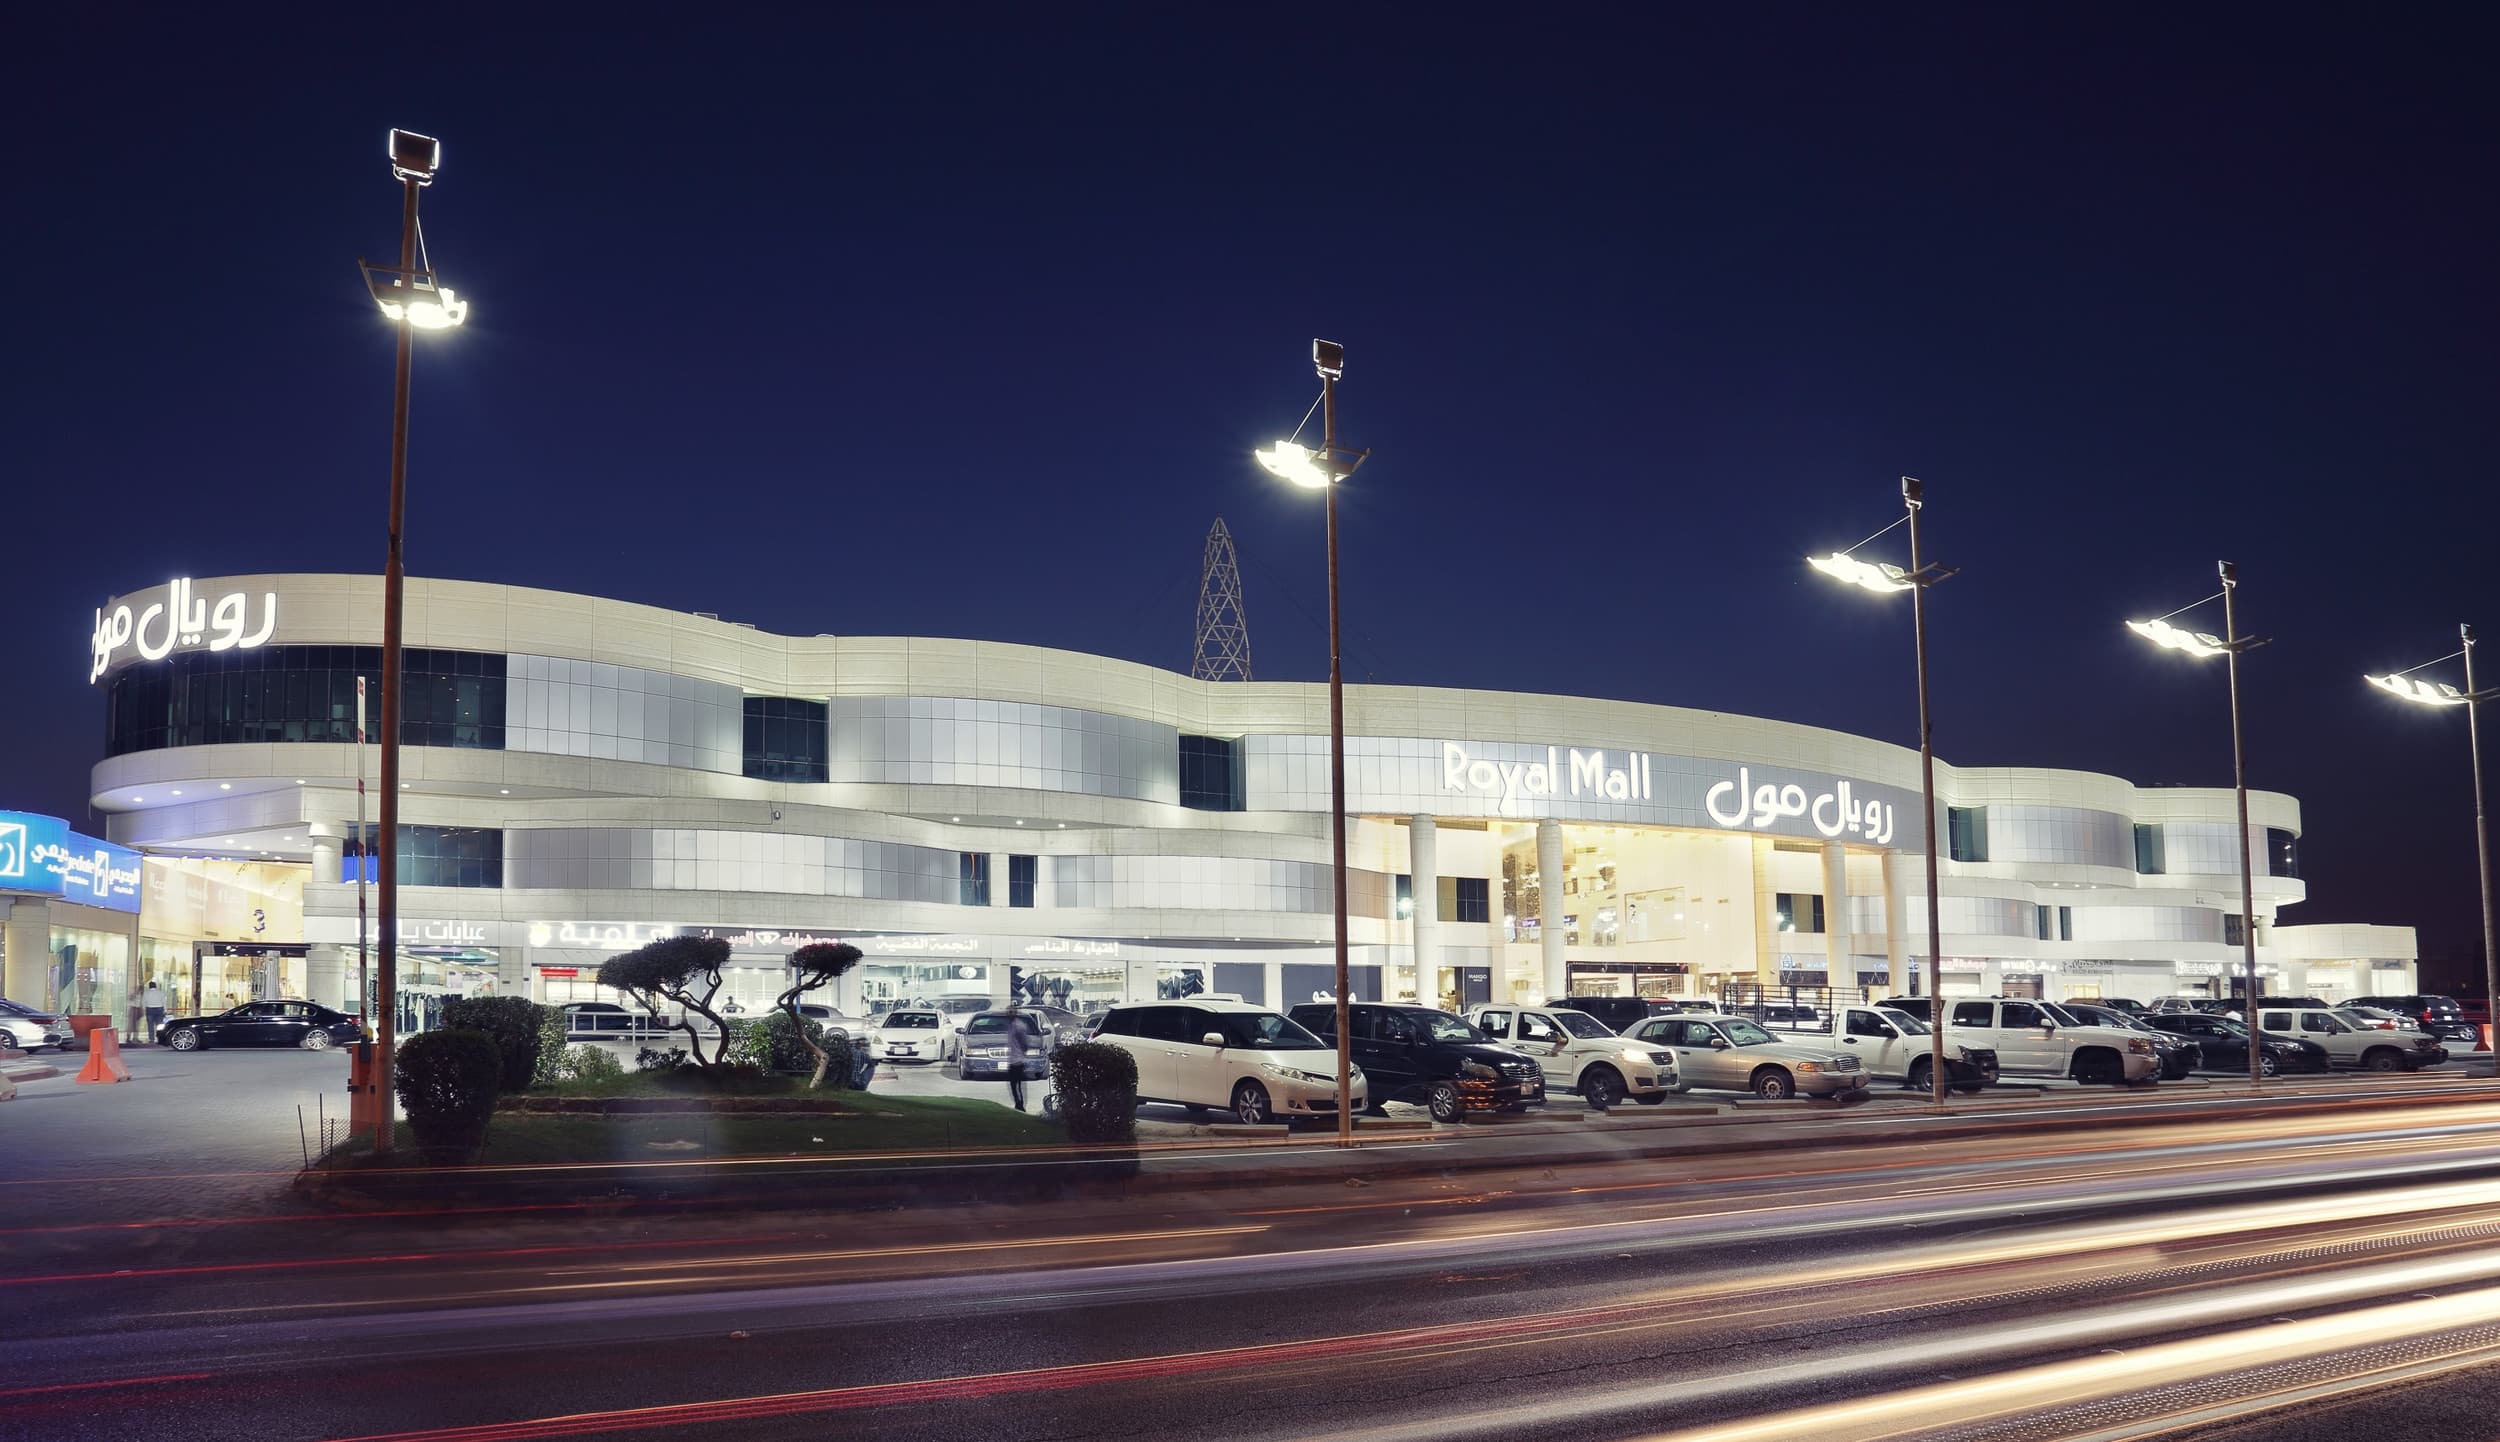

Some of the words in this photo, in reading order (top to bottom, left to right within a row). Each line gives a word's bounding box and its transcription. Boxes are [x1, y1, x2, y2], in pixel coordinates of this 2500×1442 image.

[136, 577, 277, 661] رويال
[1442, 740, 1557, 814] Royal
[1570, 746, 1650, 801] Mall
[1705, 766, 1808, 828] مول
[1811, 780, 1894, 844] رويال
[425, 919, 486, 945] عبايات
